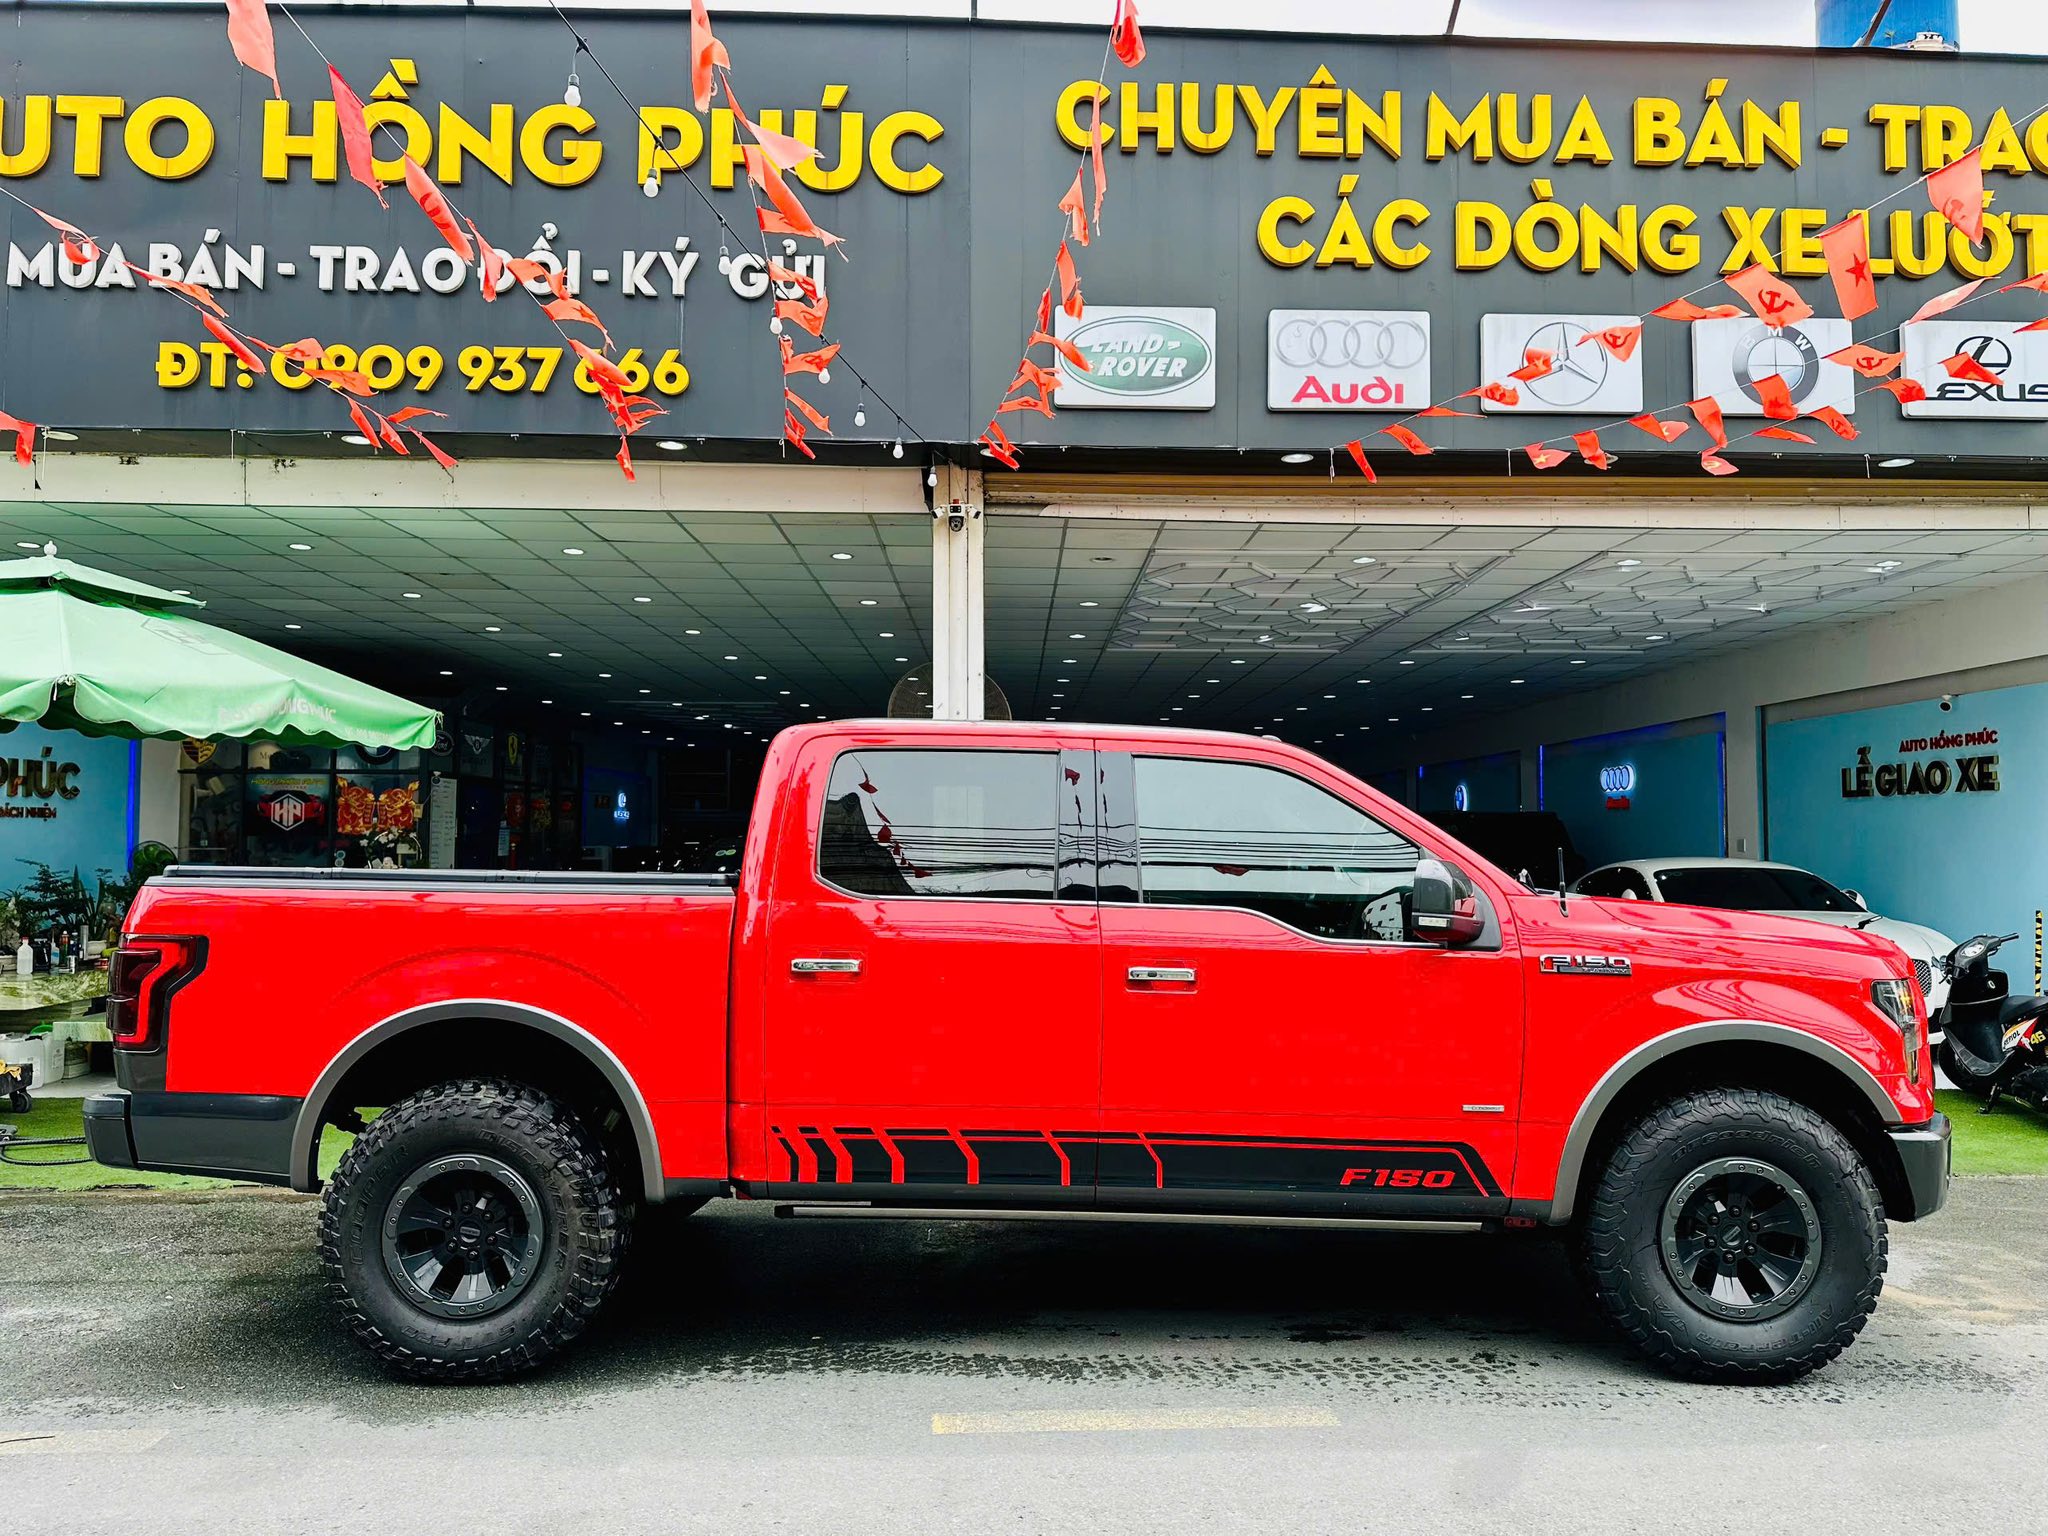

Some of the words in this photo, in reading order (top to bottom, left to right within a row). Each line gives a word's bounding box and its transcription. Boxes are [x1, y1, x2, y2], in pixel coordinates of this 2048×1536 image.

[261, 58, 603, 187] HỒNG
[637, 85, 944, 193] PHÚC
[1055, 63, 1401, 160] CHUYÊN
[1426, 90, 1614, 166] MUA
[1633, 78, 1801, 169] BÁN
[1257, 173, 1432, 270] CÁC
[1456, 178, 1701, 274] DÒNG
[1720, 205, 1829, 276] XE
[6, 241, 137, 289] MUA
[149, 228, 265, 290] BÁN
[310, 245, 467, 294] TRAO
[622, 236, 699, 296] KÝ
[728, 238, 826, 299] GỬI
[155, 341, 254, 388] ĐT:
[457, 345, 564, 392] 937
[1097, 356, 1188, 377] ROVER
[1291, 375, 1404, 404] Audi
[1926, 382, 2048, 402] EXUS
[1899, 739, 1929, 753] AUTO
[1965, 727, 1998, 747] PHÚC
[1875, 759, 1952, 797] GIAO
[1955, 754, 2000, 793] XE
[1340, 1168, 1456, 1188] F150
